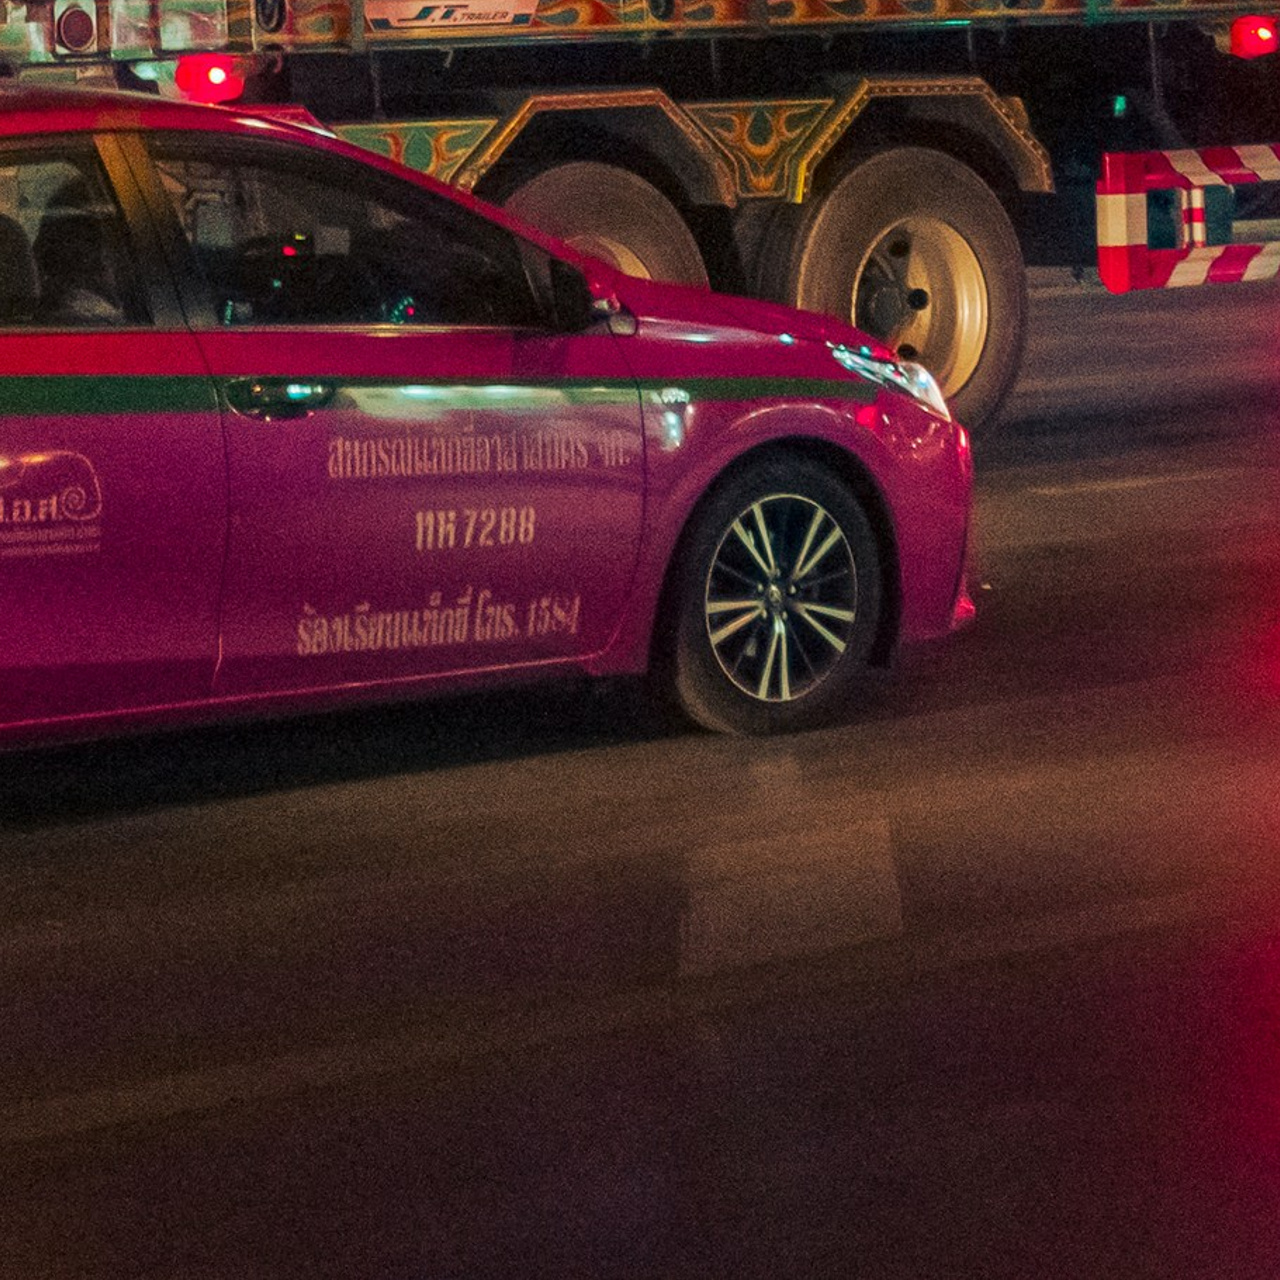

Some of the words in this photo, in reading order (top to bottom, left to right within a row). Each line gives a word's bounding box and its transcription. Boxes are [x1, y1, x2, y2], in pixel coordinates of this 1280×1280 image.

[415, 509, 457, 552] ทห
[463, 505, 537, 549] 7288
[296, 586, 472, 656] ร้องเรียนแท็กซี่
[474, 589, 519, 643] โทร.
[526, 595, 580, 638] 1584
